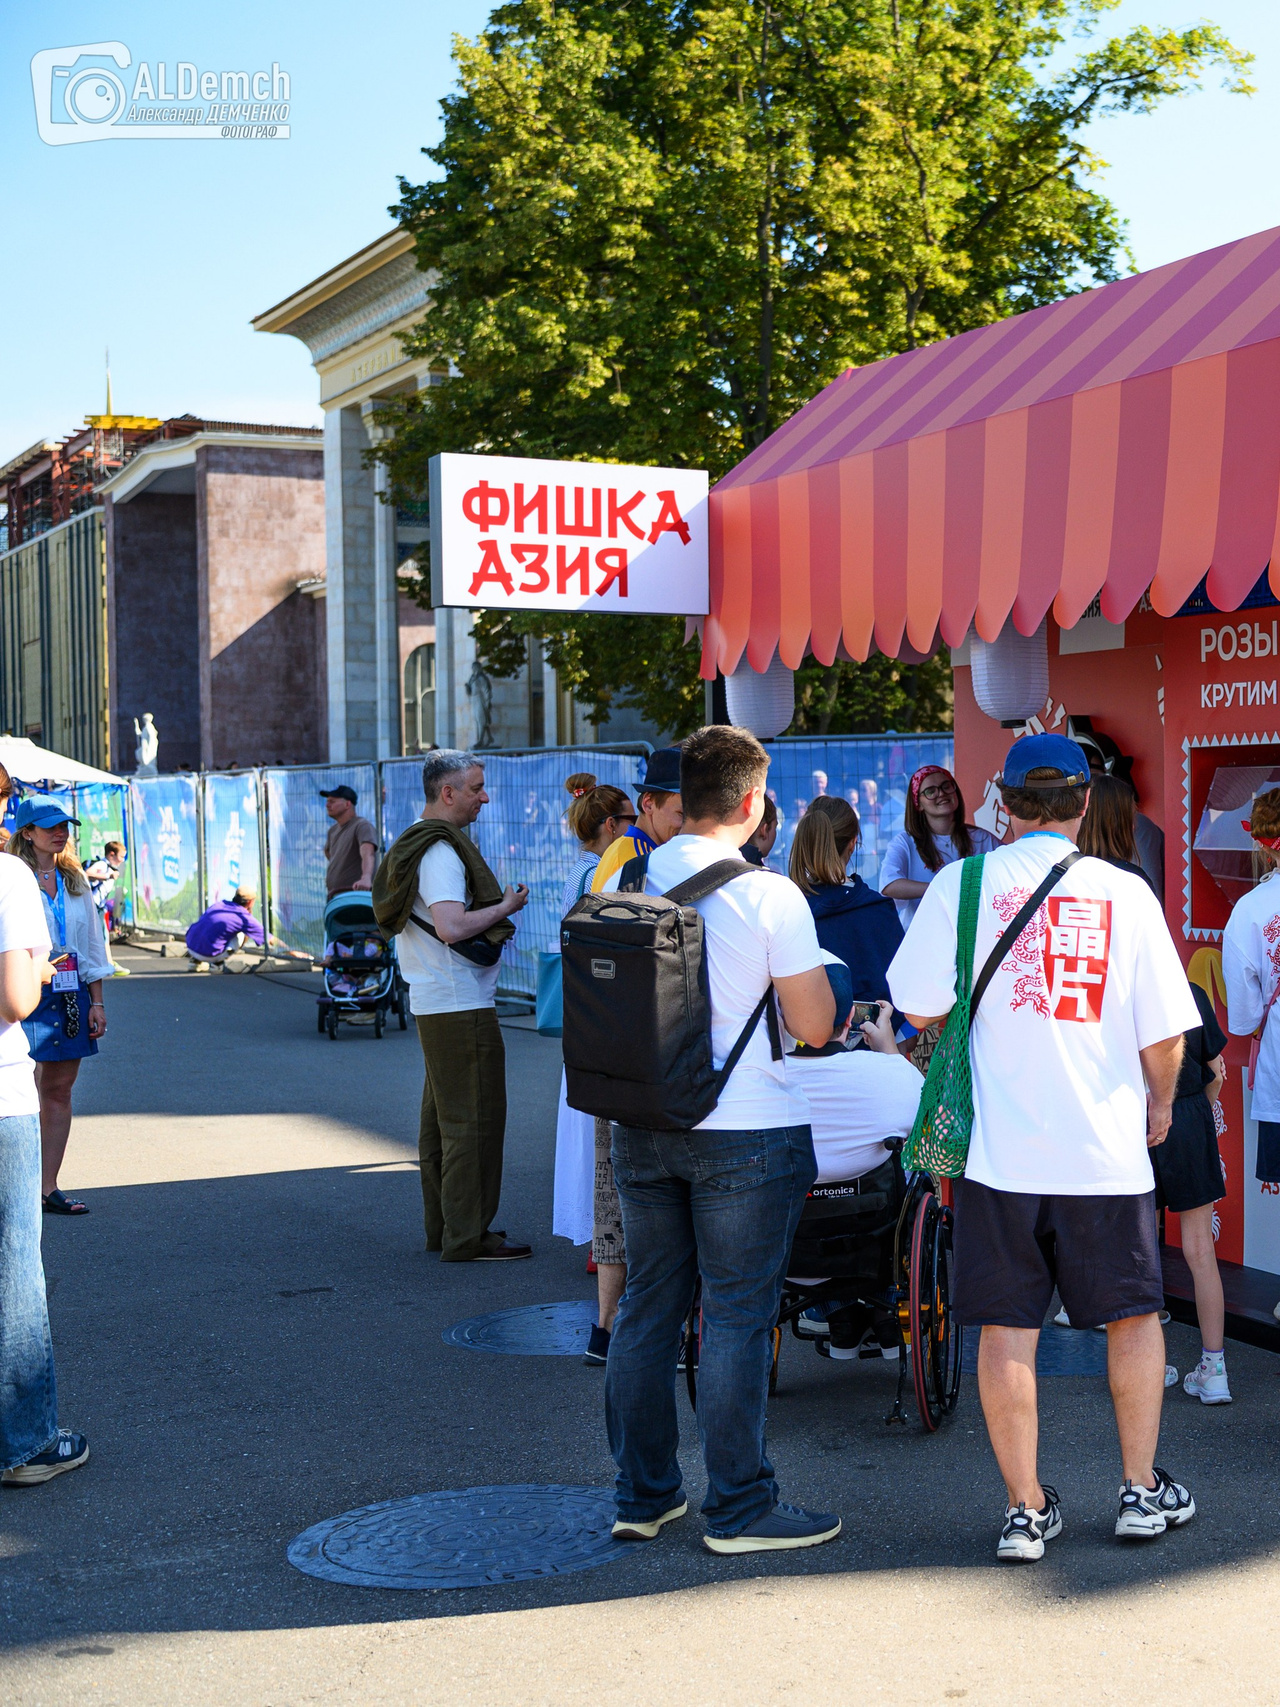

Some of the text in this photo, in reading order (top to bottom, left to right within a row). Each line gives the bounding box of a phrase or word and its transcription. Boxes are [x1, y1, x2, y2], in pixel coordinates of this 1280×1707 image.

[462, 480, 692, 546] ФИШКА
[468, 539, 629, 597] АЗИЯ
[1201, 680, 1277, 708] КРУТИМ
[1050, 901, 1106, 1018] 晶片
[813, 1186, 854, 1196] ortonica
